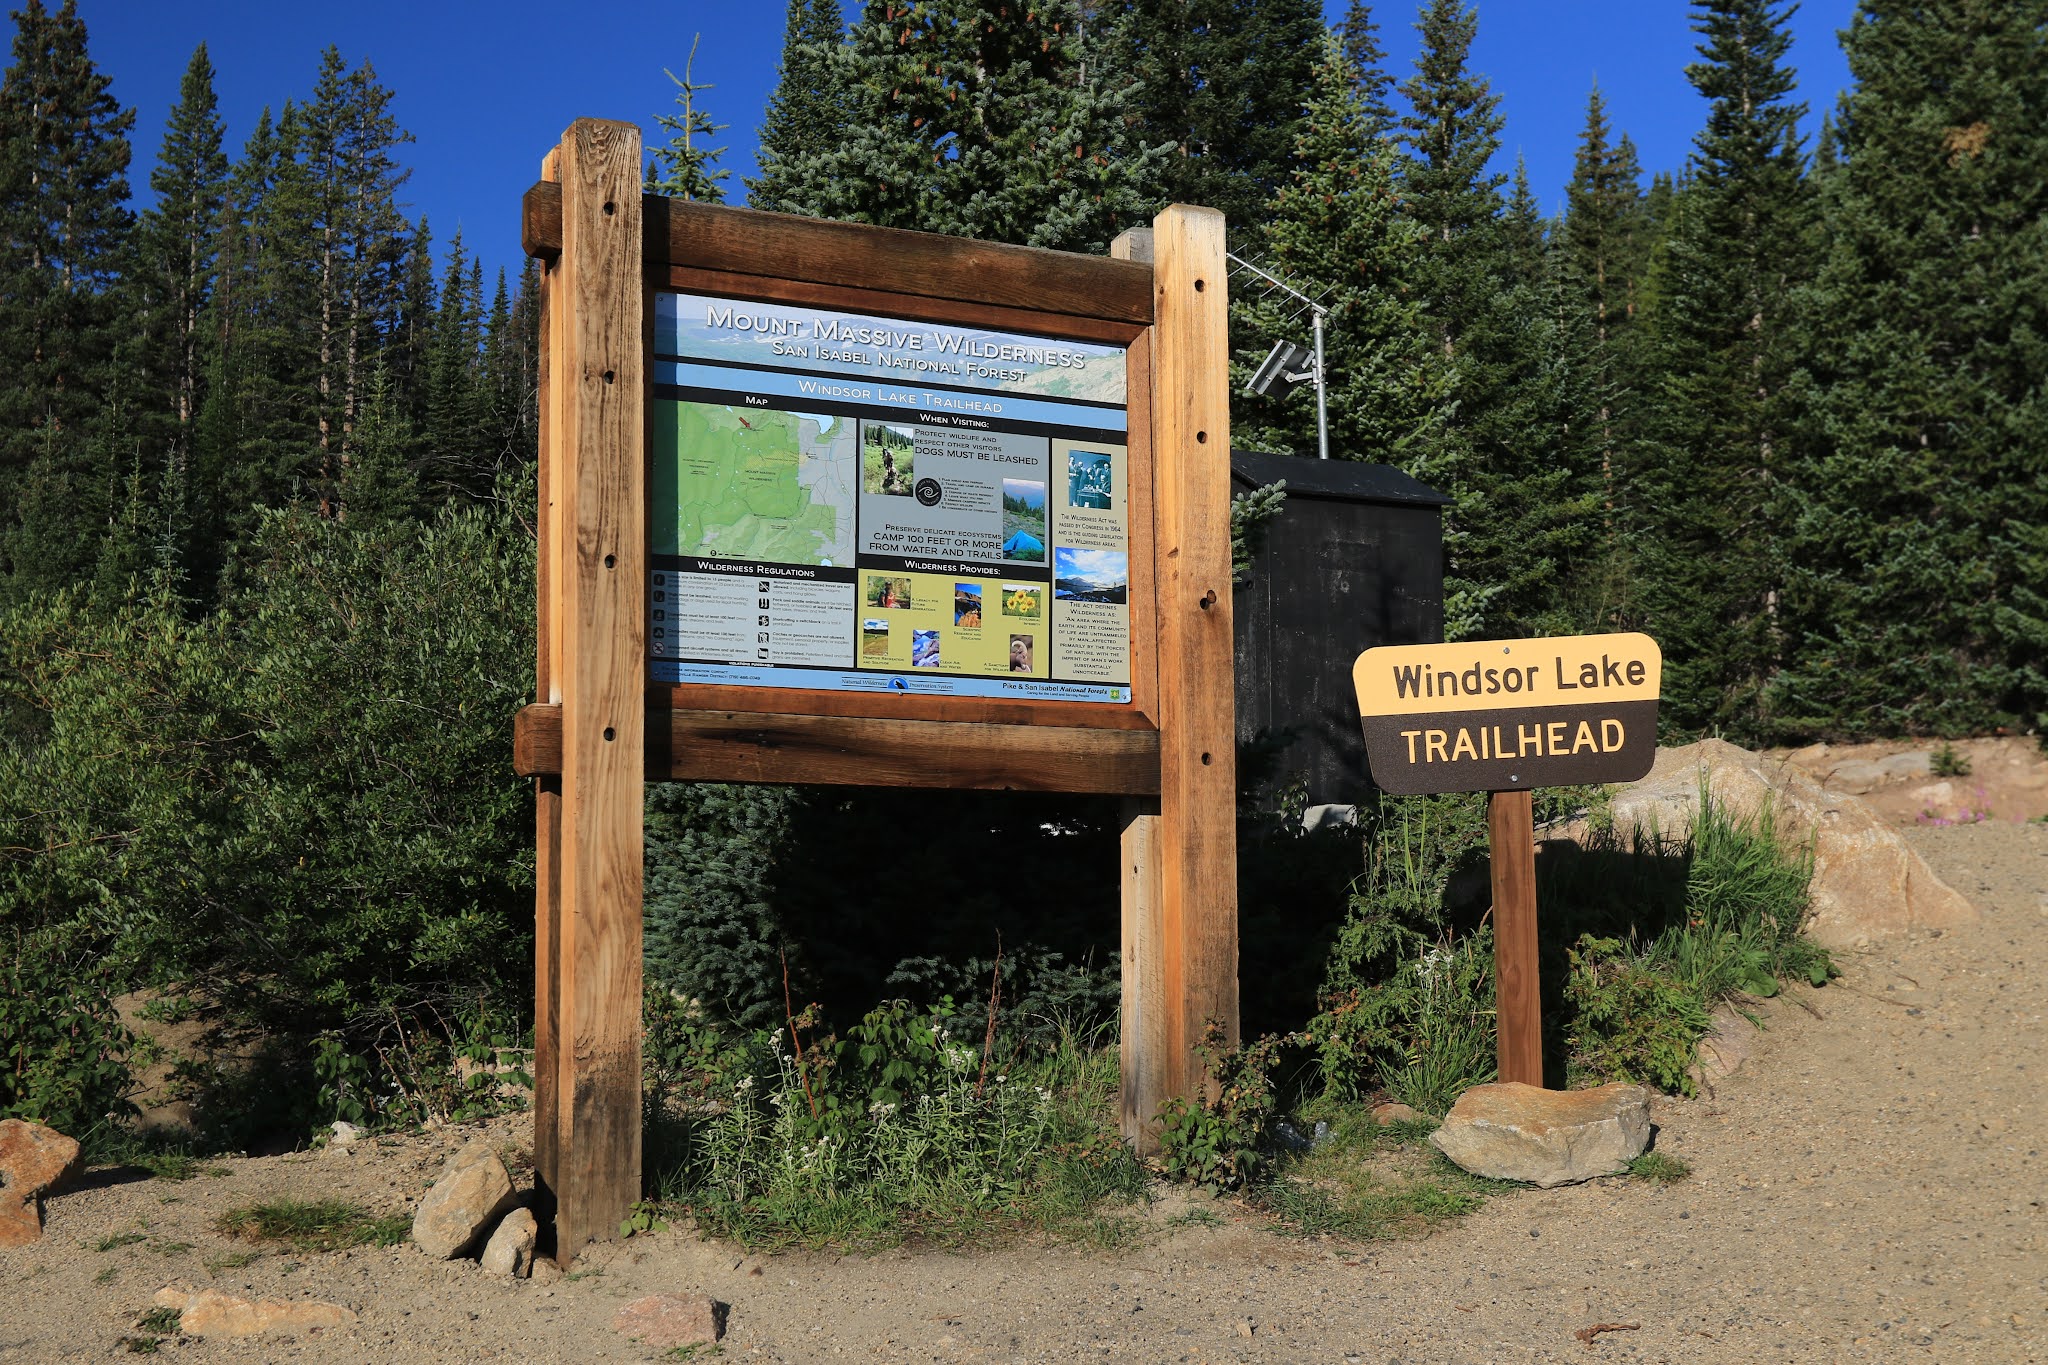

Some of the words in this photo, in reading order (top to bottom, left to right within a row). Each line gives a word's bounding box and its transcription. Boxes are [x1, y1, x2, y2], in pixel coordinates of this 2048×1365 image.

[706, 305, 802, 336] MOUNT
[813, 317, 922, 350] MASSIVE
[934, 332, 1085, 369] WILDERNESS
[773, 341, 808, 358] SAN
[816, 345, 871, 365] ISABEL
[878, 352, 960, 375] NATIONAL
[967, 363, 1027, 382] FOREST
[745, 396, 768, 405] MAP
[798, 380, 871, 399] WINDSOR
[878, 388, 917, 404] LAKE
[923, 393, 1002, 413] TRAILHEAD
[920, 414, 948, 424] WHEN
[952, 417, 989, 428] VISITING:
[915, 429, 946, 438] PROTECT
[949, 433, 980, 441] WILDLIFE
[915, 447, 944, 456] DOGS
[947, 450, 974, 459] MUST
[994, 454, 1038, 465] LEASHED
[885, 524, 921, 533] PRESERVE
[874, 533, 904, 541] CAMP
[908, 535, 924, 543] 100
[928, 537, 951, 545] FEET
[955, 539, 968, 547] OR
[973, 541, 1001, 549] MORE
[869, 543, 898, 552] FROM
[902, 545, 937, 555] WATER
[942, 548, 963, 556] AND
[967, 550, 1002, 559] TRAILS
[698, 560, 753, 573] WILDERNESS
[757, 565, 815, 577] REGULATIONS
[905, 560, 957, 572] WILDERNESS
[960, 564, 1000, 575] PROVIDES:
[1393, 661, 1539, 698] Windsor
[1555, 654, 1646, 690] Lake
[1039, 684, 1058, 692] Isabel
[1400, 719, 1625, 764] TRAILHEAD
